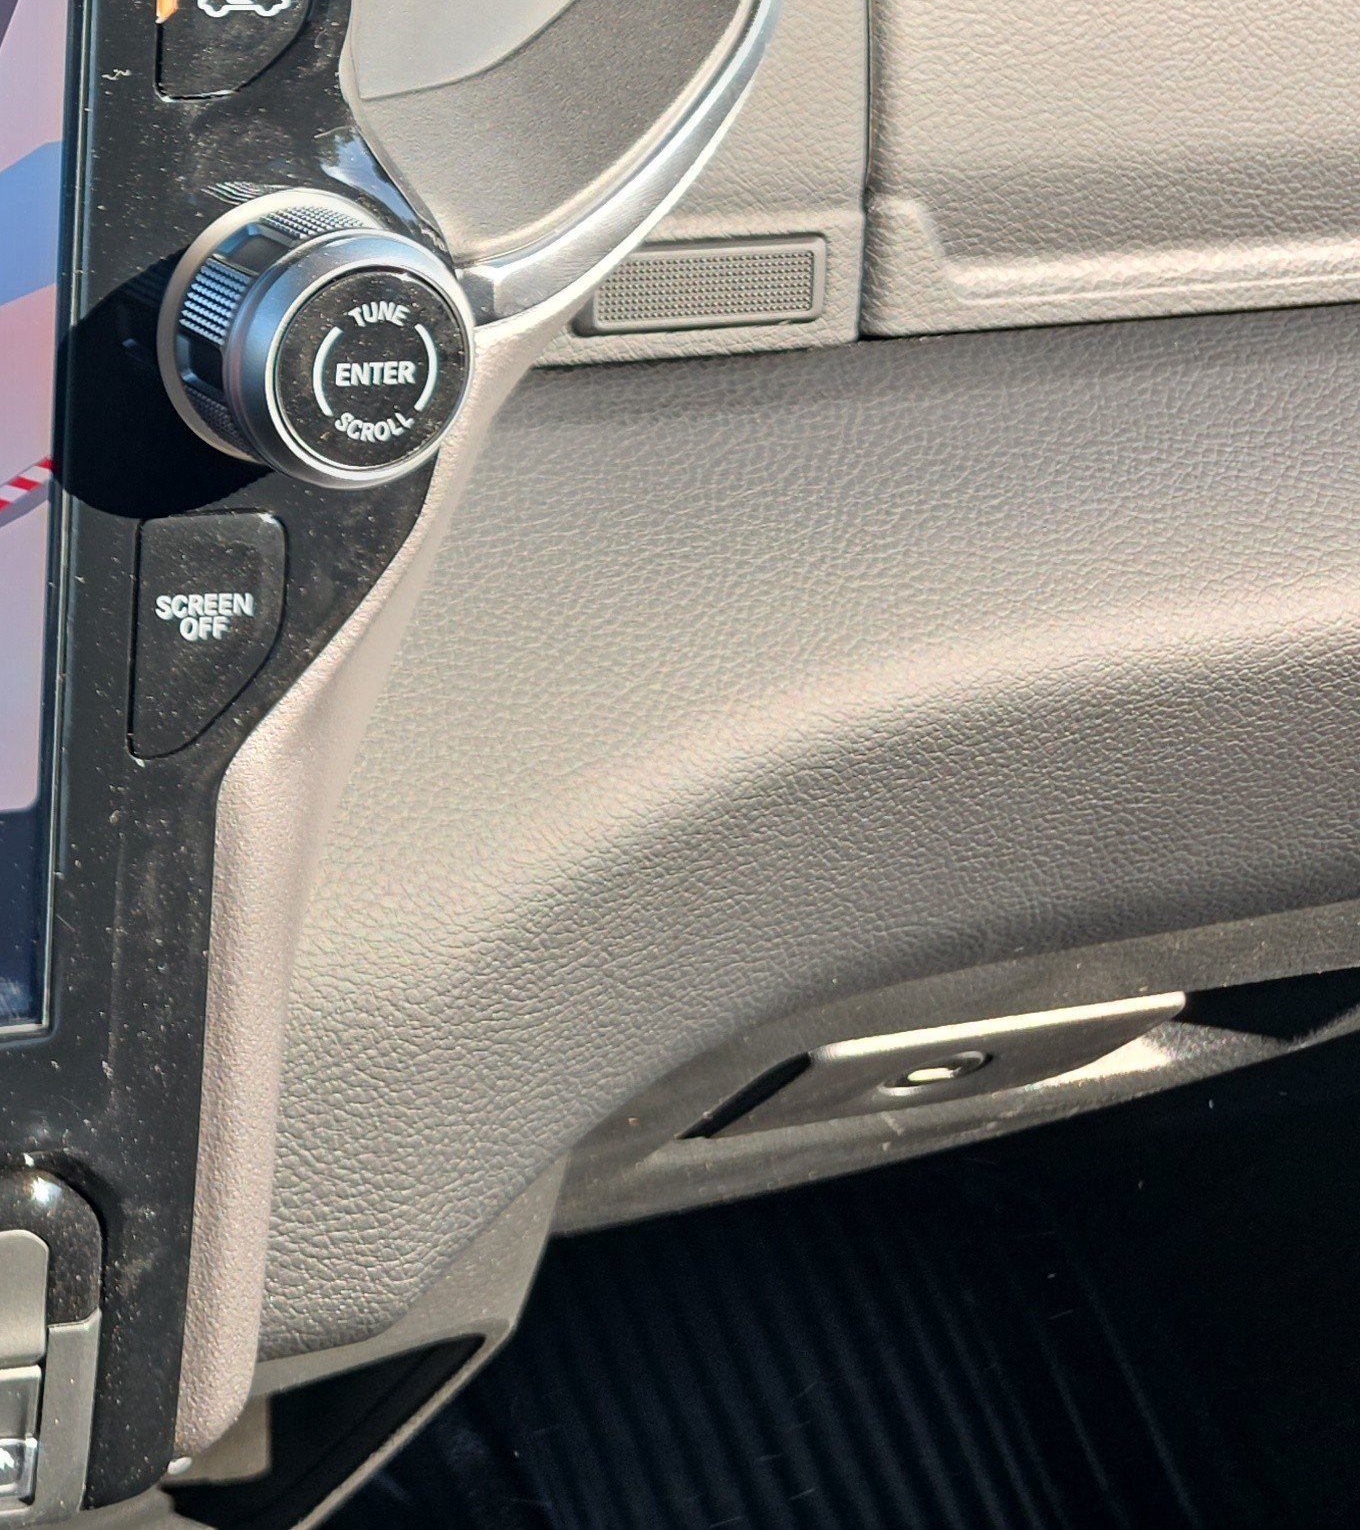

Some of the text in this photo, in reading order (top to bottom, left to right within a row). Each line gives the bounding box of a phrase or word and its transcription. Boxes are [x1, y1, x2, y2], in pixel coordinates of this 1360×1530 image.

[348, 301, 411, 328] TUNE
[335, 360, 416, 387] ENTER
[334, 412, 416, 443] SCROLL
[155, 592, 255, 621] SCREEN
[179, 616, 231, 642] OFF
